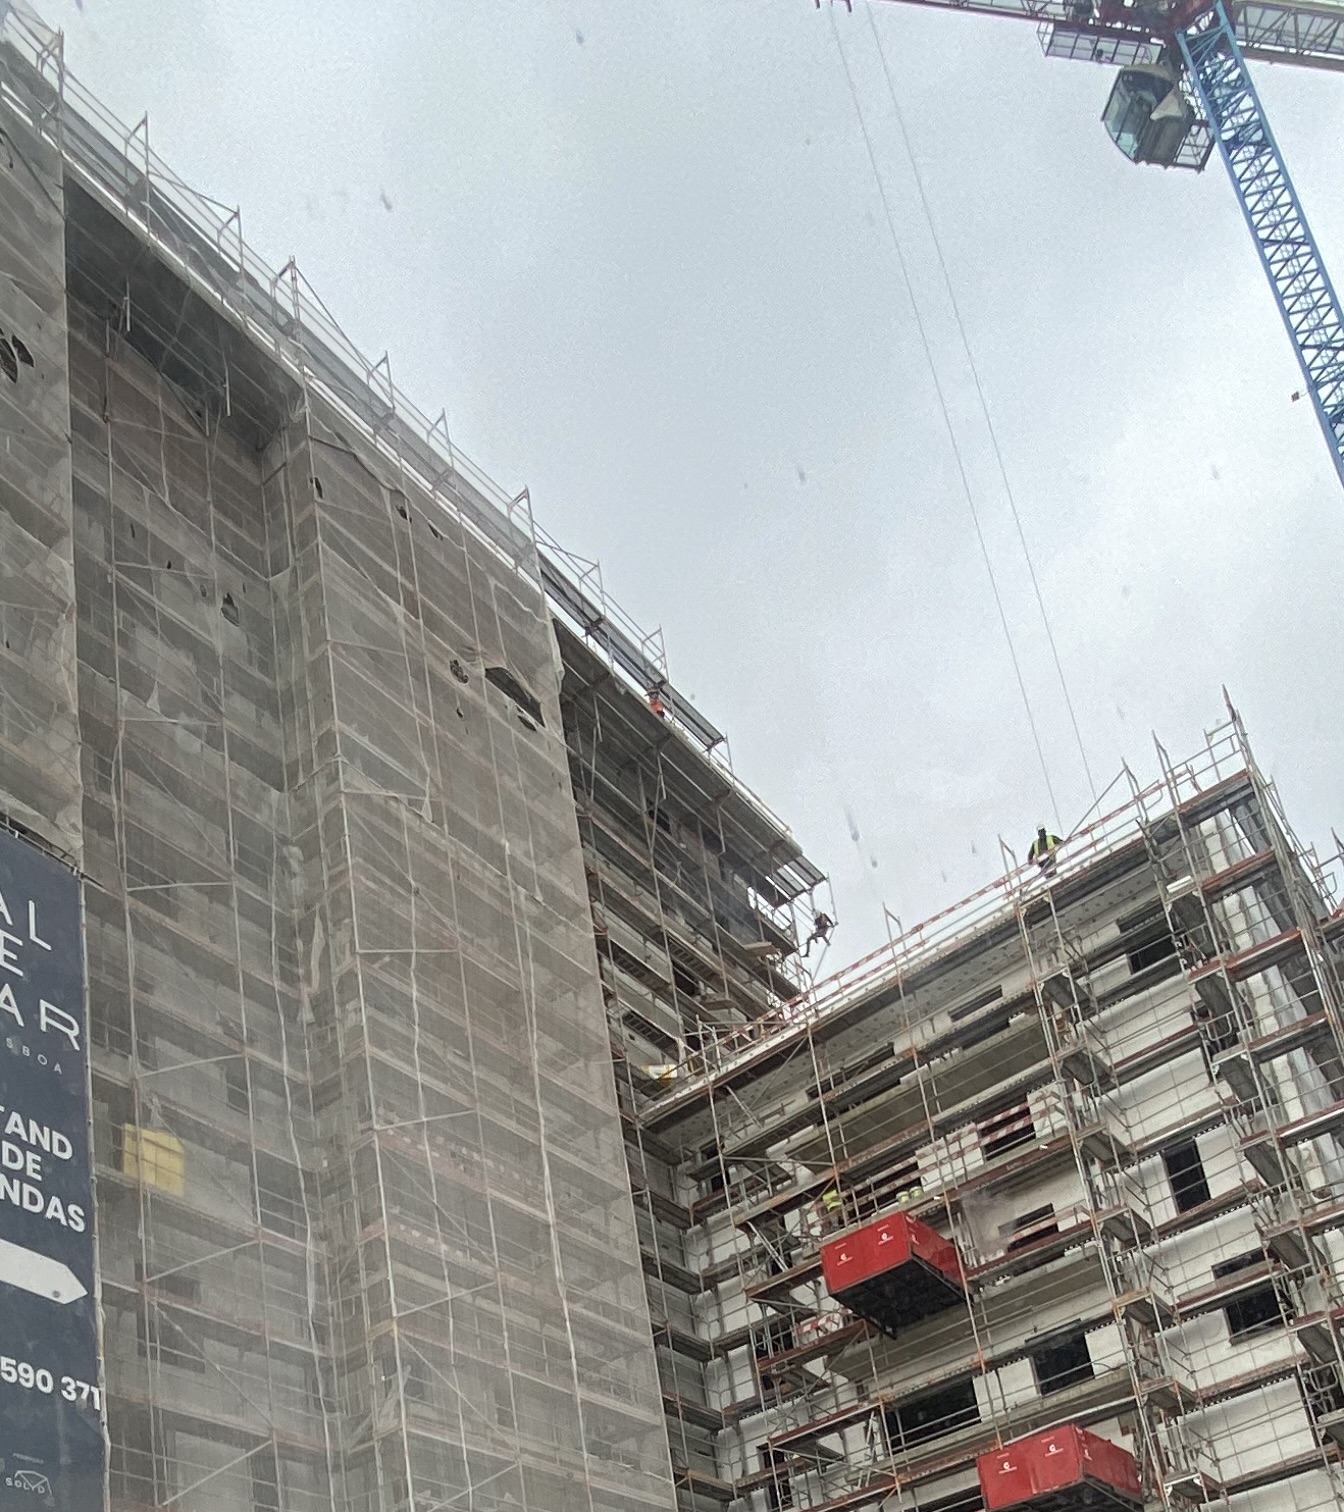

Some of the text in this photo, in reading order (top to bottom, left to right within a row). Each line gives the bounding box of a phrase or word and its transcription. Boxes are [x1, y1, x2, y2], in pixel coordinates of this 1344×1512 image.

[1, 1140, 42, 1182] DE
[0, 1355, 54, 1394] 590
[61, 1375, 101, 1411] 371
